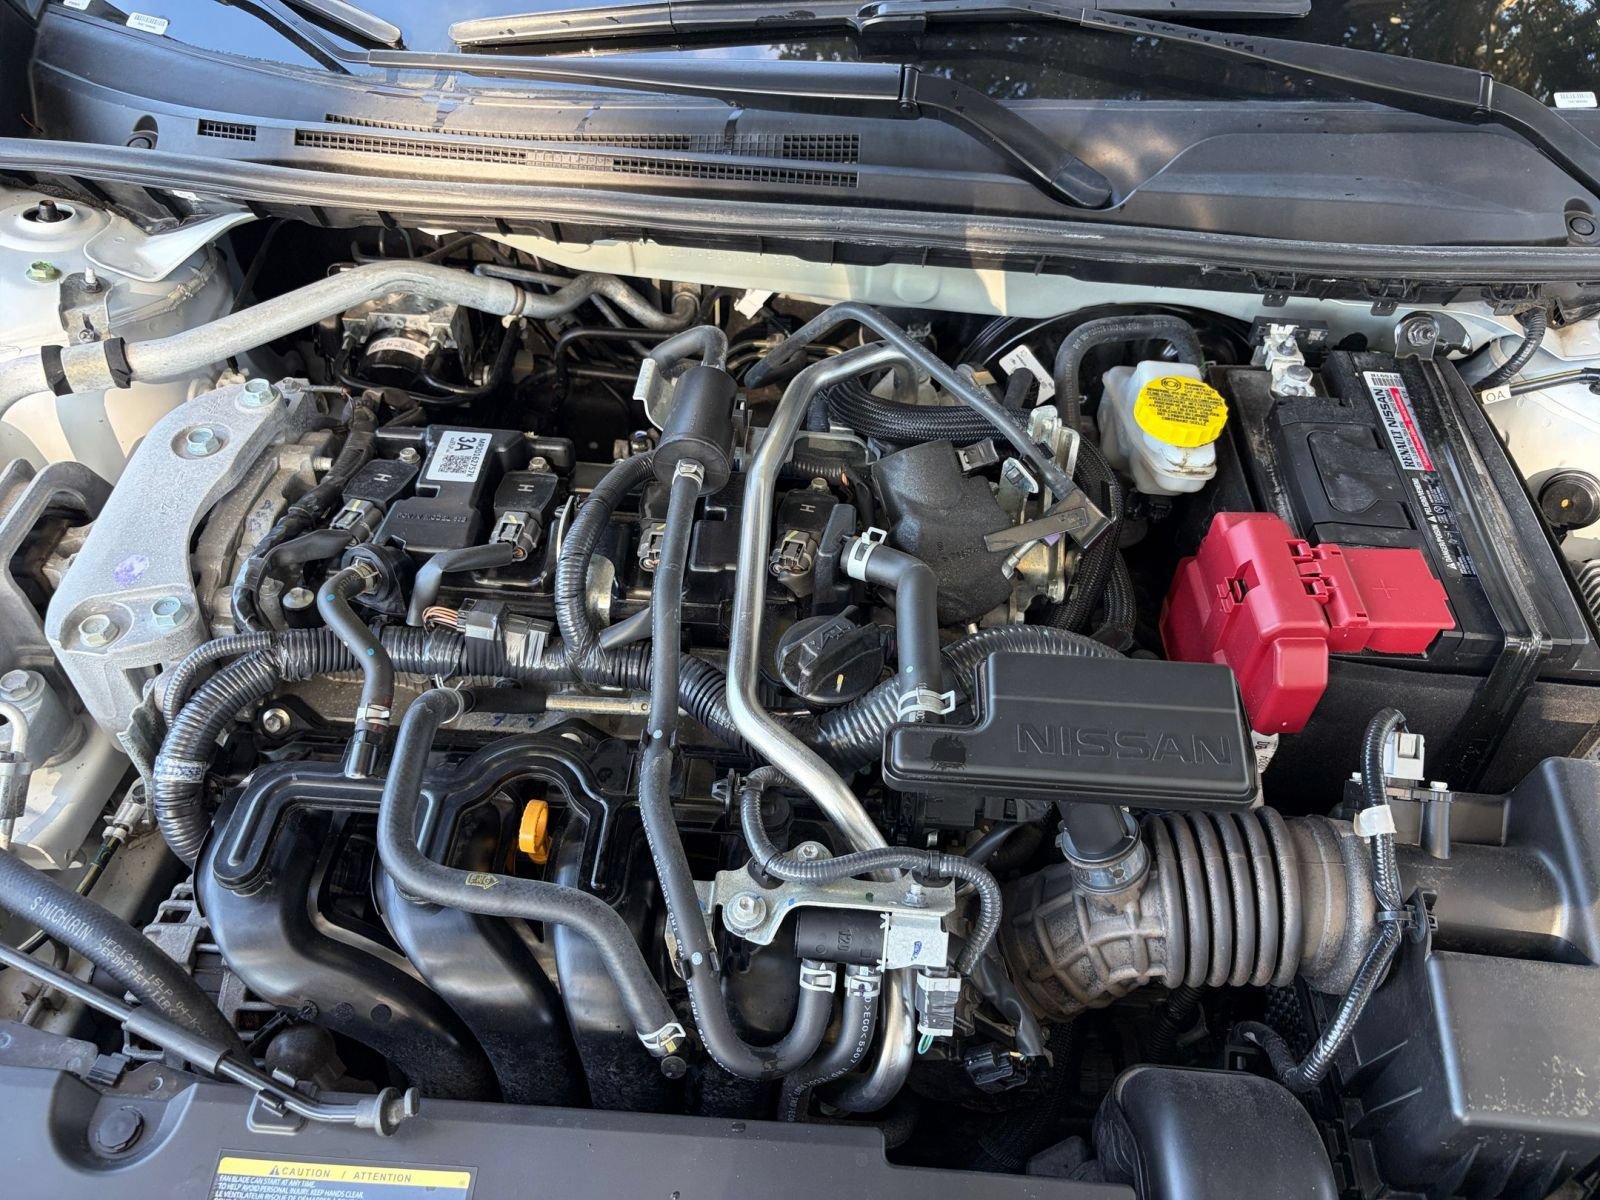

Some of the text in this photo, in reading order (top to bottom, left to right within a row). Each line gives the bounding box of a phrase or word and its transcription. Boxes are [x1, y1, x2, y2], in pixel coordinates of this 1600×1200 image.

[1373, 388, 1399, 428] NISSAN
[454, 436, 477, 451] 3A
[1390, 430, 1415, 468] RENAULT
[373, 473, 392, 482] H
[517, 484, 535, 492] H
[799, 503, 817, 513] H
[1016, 722, 1233, 766] NISSAN
[281, 1166, 330, 1178] CAUTION
[353, 1171, 412, 1182] ATTENTION
